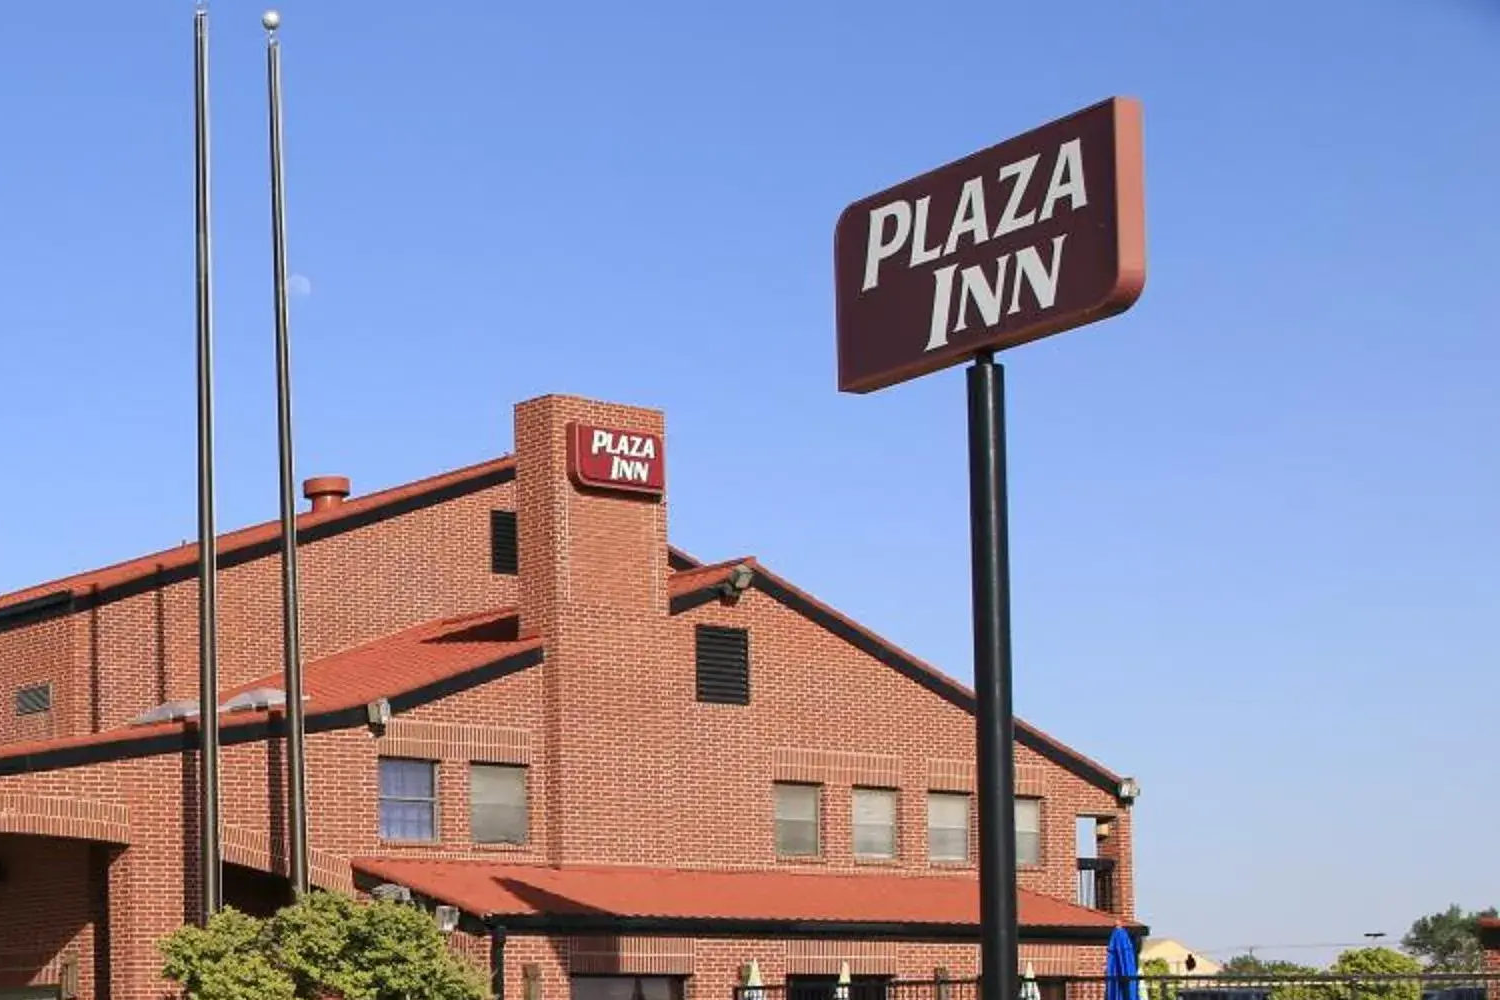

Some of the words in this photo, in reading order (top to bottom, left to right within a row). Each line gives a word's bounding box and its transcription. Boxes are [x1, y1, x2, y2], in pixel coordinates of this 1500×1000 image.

[861, 137, 1088, 292] PLAZA
[923, 233, 1068, 352] INN
[591, 429, 655, 459] PLAZA
[610, 456, 649, 483] INN
